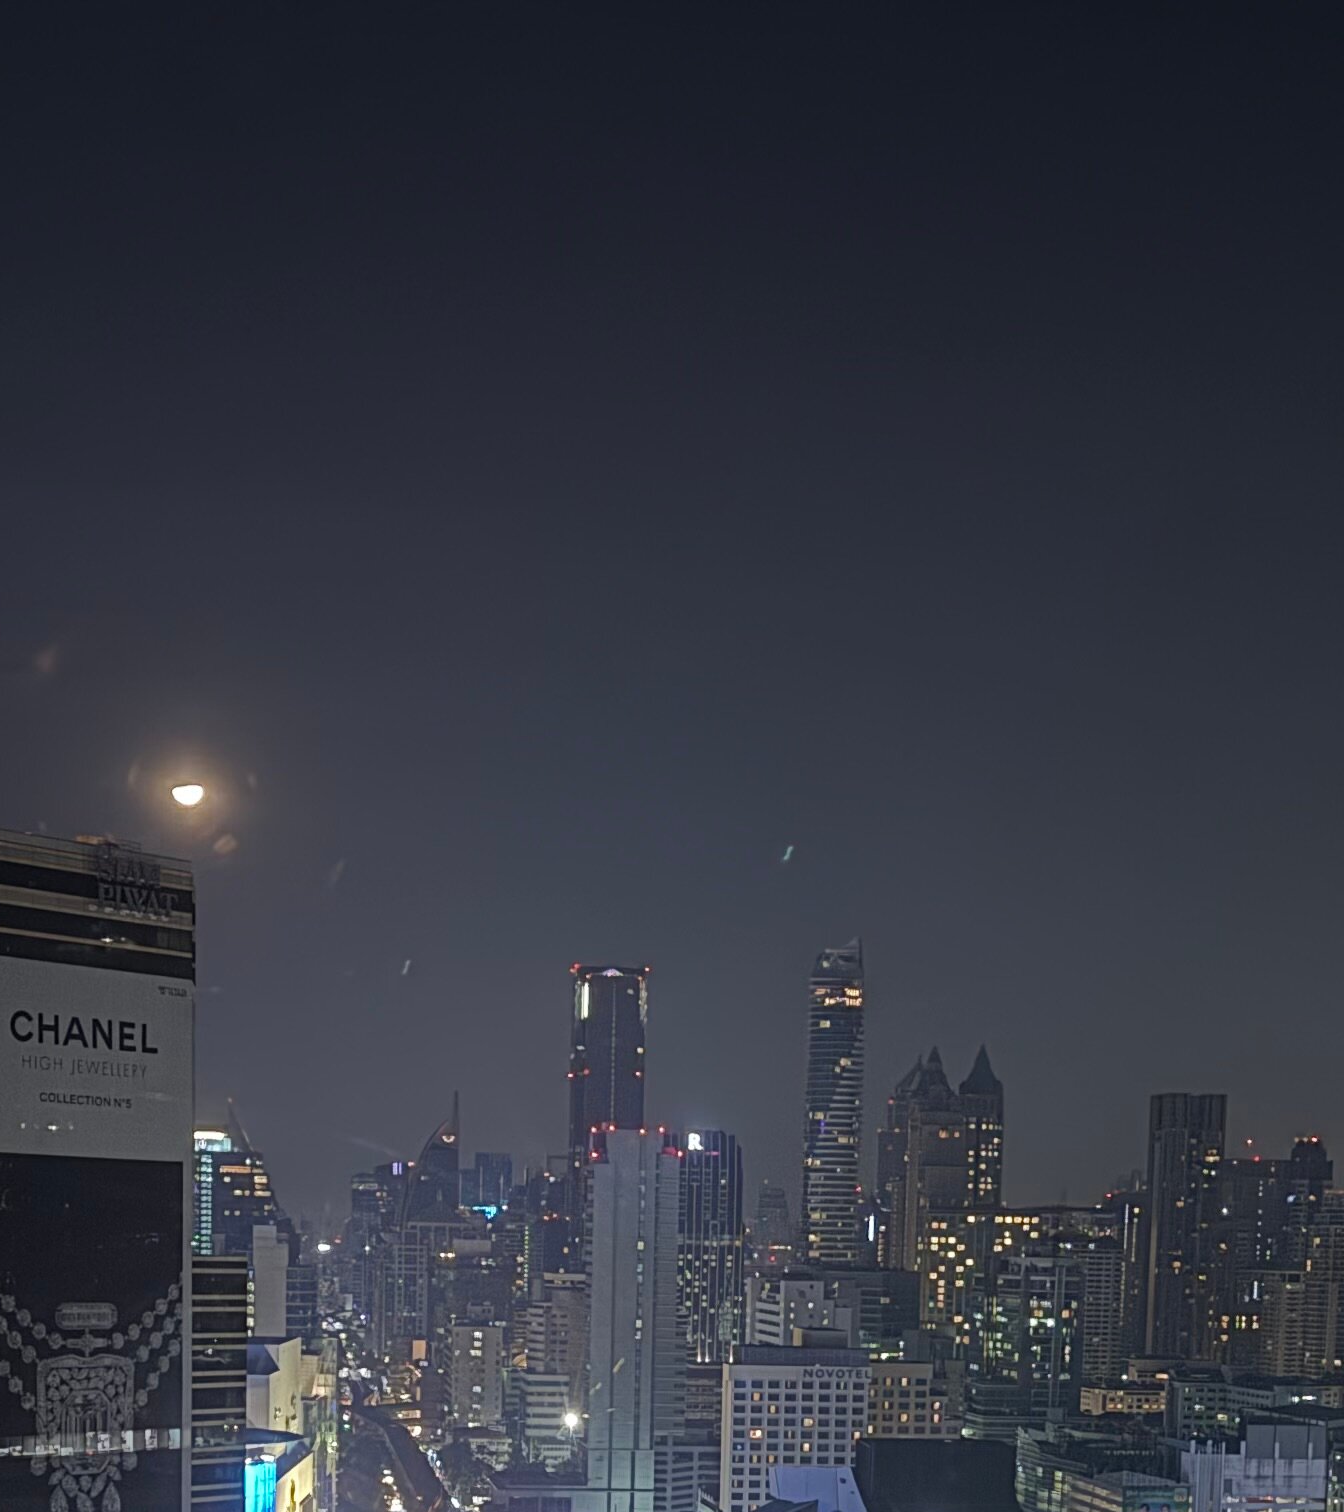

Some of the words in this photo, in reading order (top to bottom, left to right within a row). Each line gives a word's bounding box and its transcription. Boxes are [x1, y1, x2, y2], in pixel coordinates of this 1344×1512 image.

[10, 1010, 159, 1054] CHANEL
[21, 1055, 63, 1072] HIGH
[70, 1058, 148, 1079] JEWELLERY
[39, 1092, 111, 1107] COLLECTION
[803, 1368, 872, 1380] NOVOTEL
